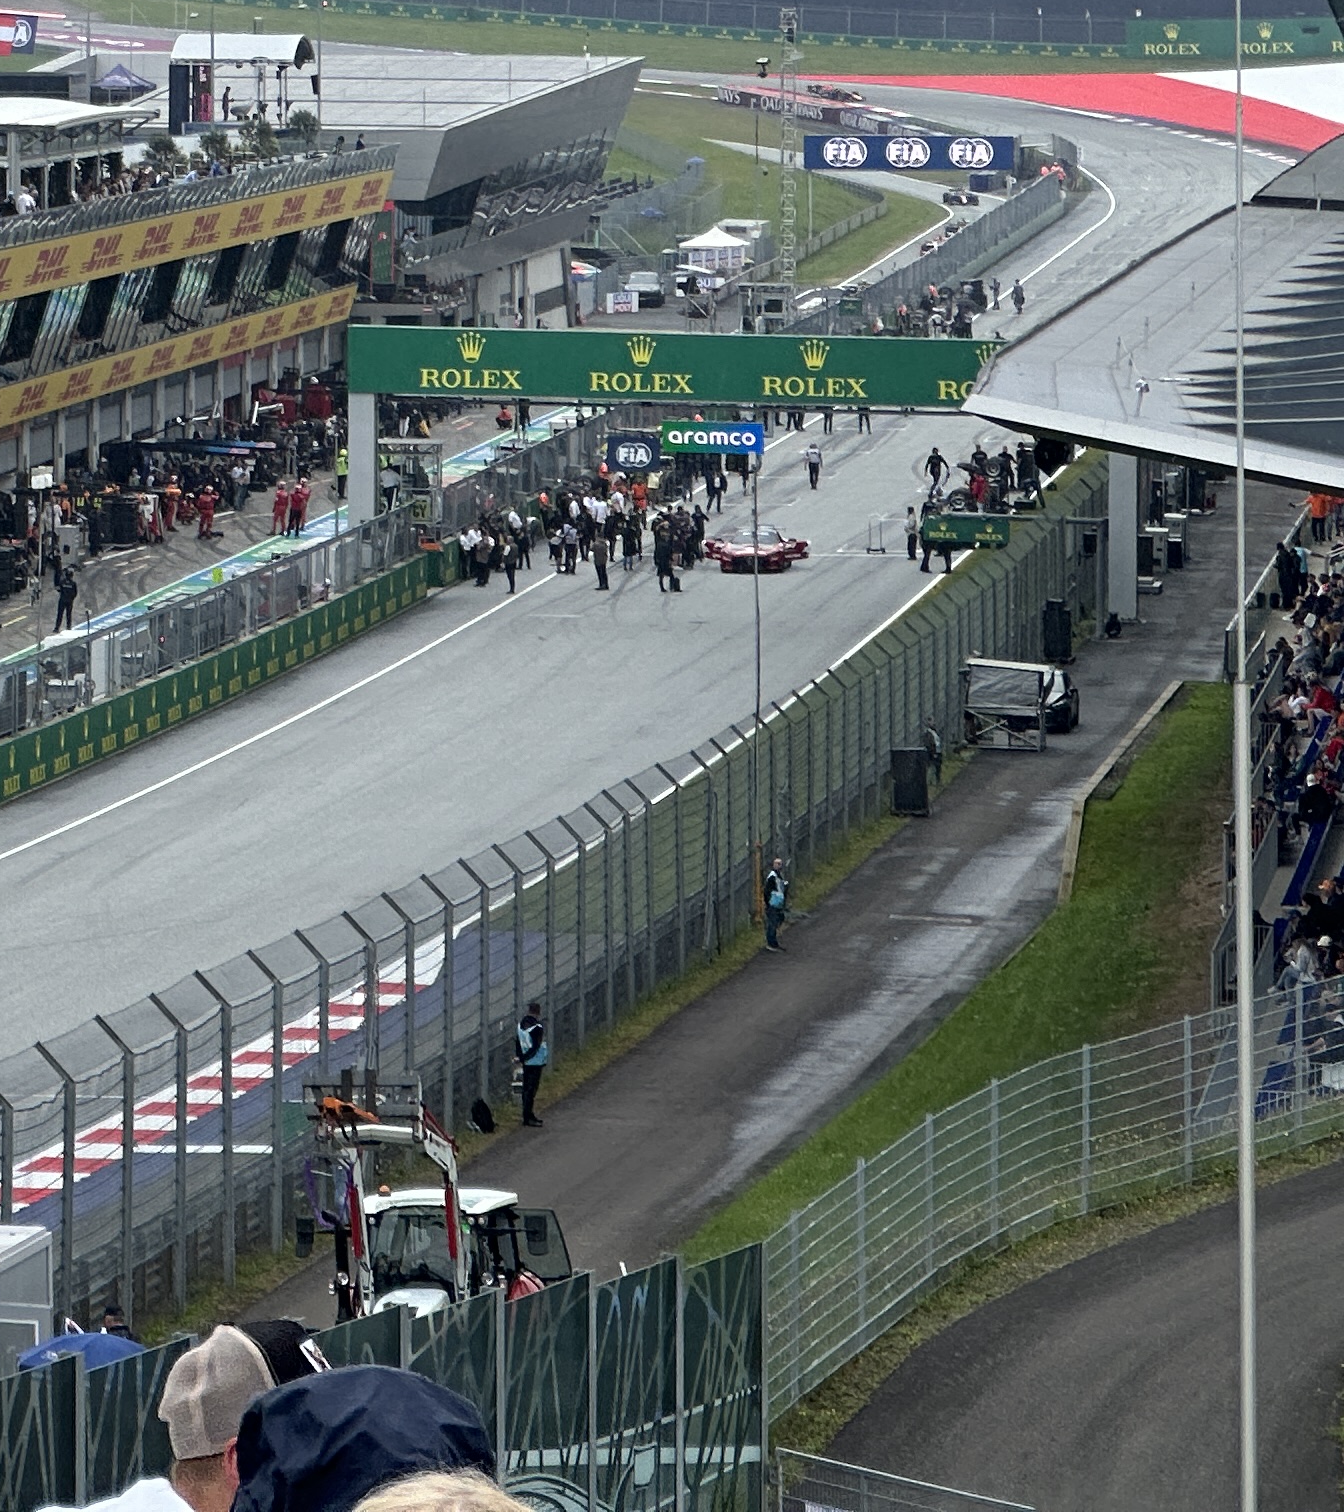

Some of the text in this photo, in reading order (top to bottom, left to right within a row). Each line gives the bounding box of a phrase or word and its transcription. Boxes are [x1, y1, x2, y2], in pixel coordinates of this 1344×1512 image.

[1144, 43, 1201, 56] ROLEX
[419, 368, 523, 390] ROLEX
[590, 372, 693, 394] ROLEX
[762, 376, 867, 399] ROLEX
[668, 430, 757, 447] aramco
